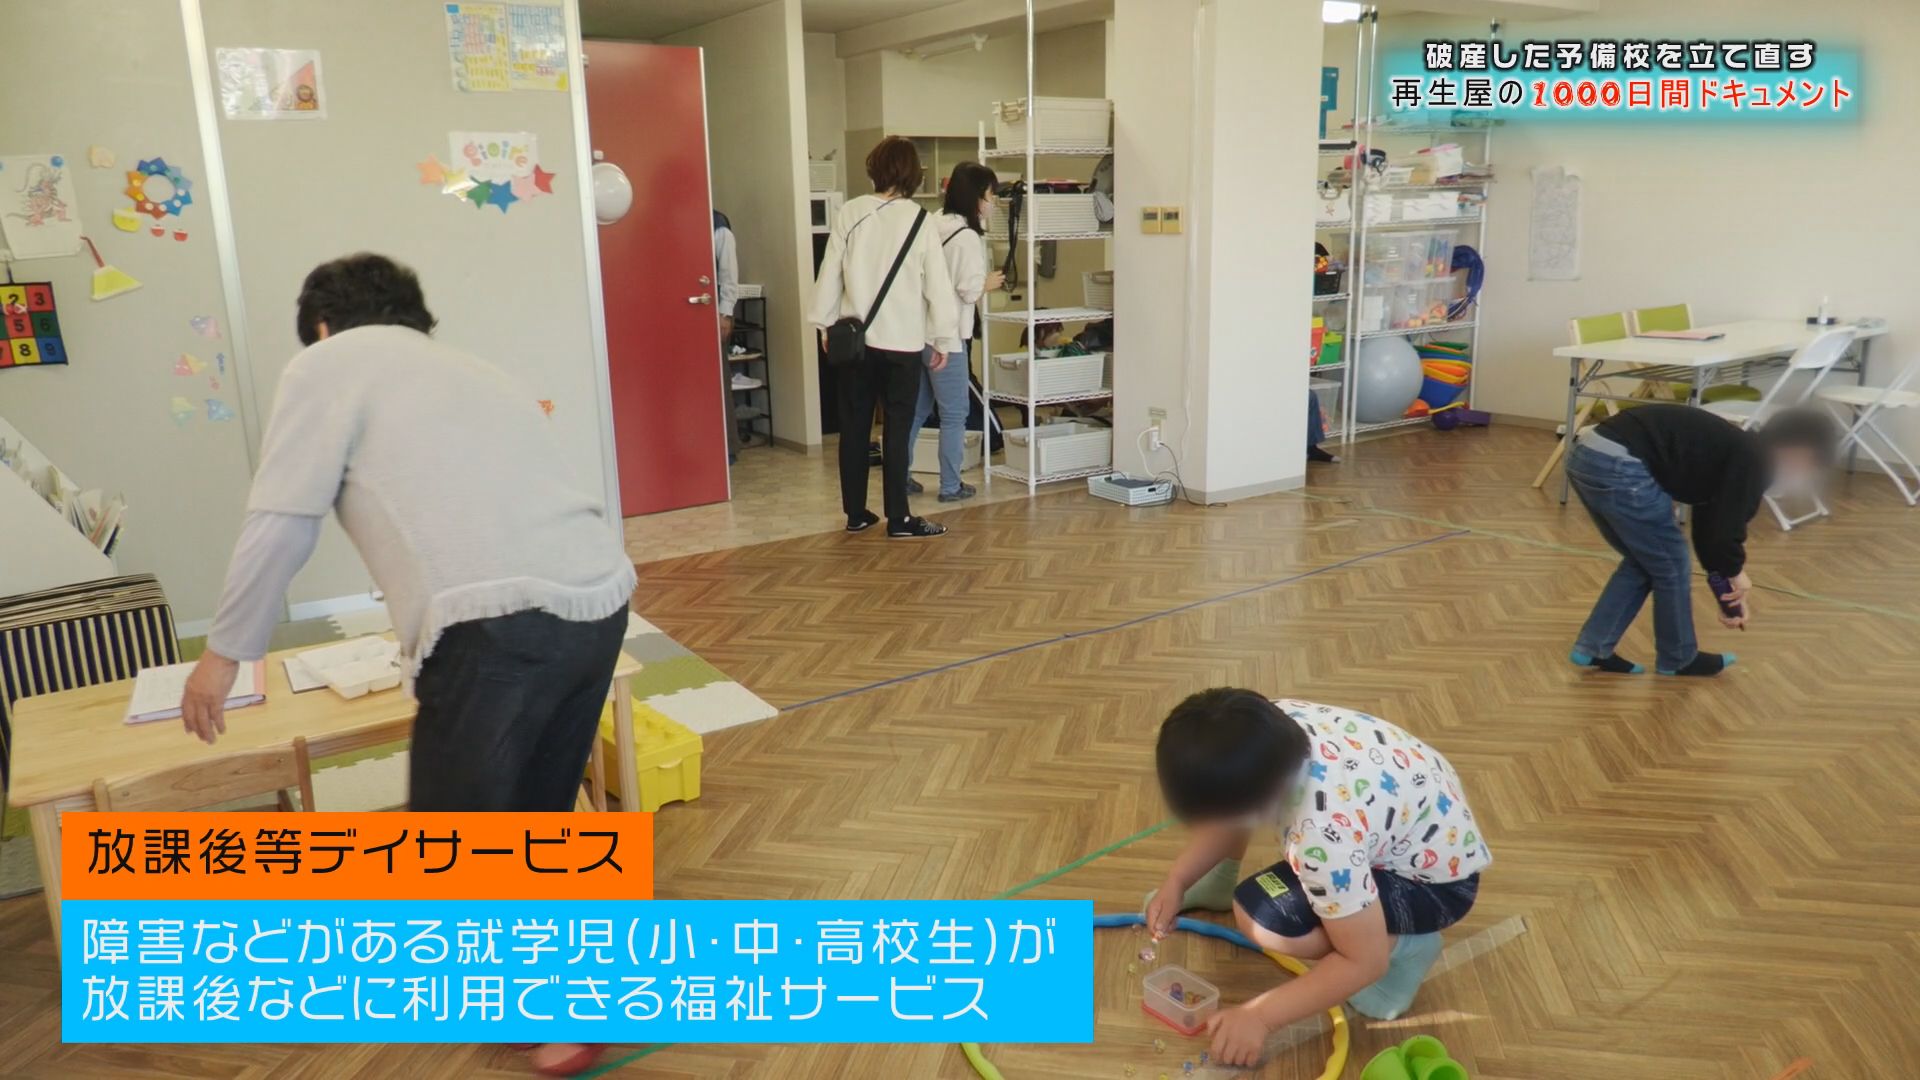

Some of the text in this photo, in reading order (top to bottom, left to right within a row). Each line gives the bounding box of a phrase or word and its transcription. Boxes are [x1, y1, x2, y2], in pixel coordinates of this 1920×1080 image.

[34, 292, 45, 306] 3
[14, 319, 25, 332] 5
[19, 343, 31, 357] 8
